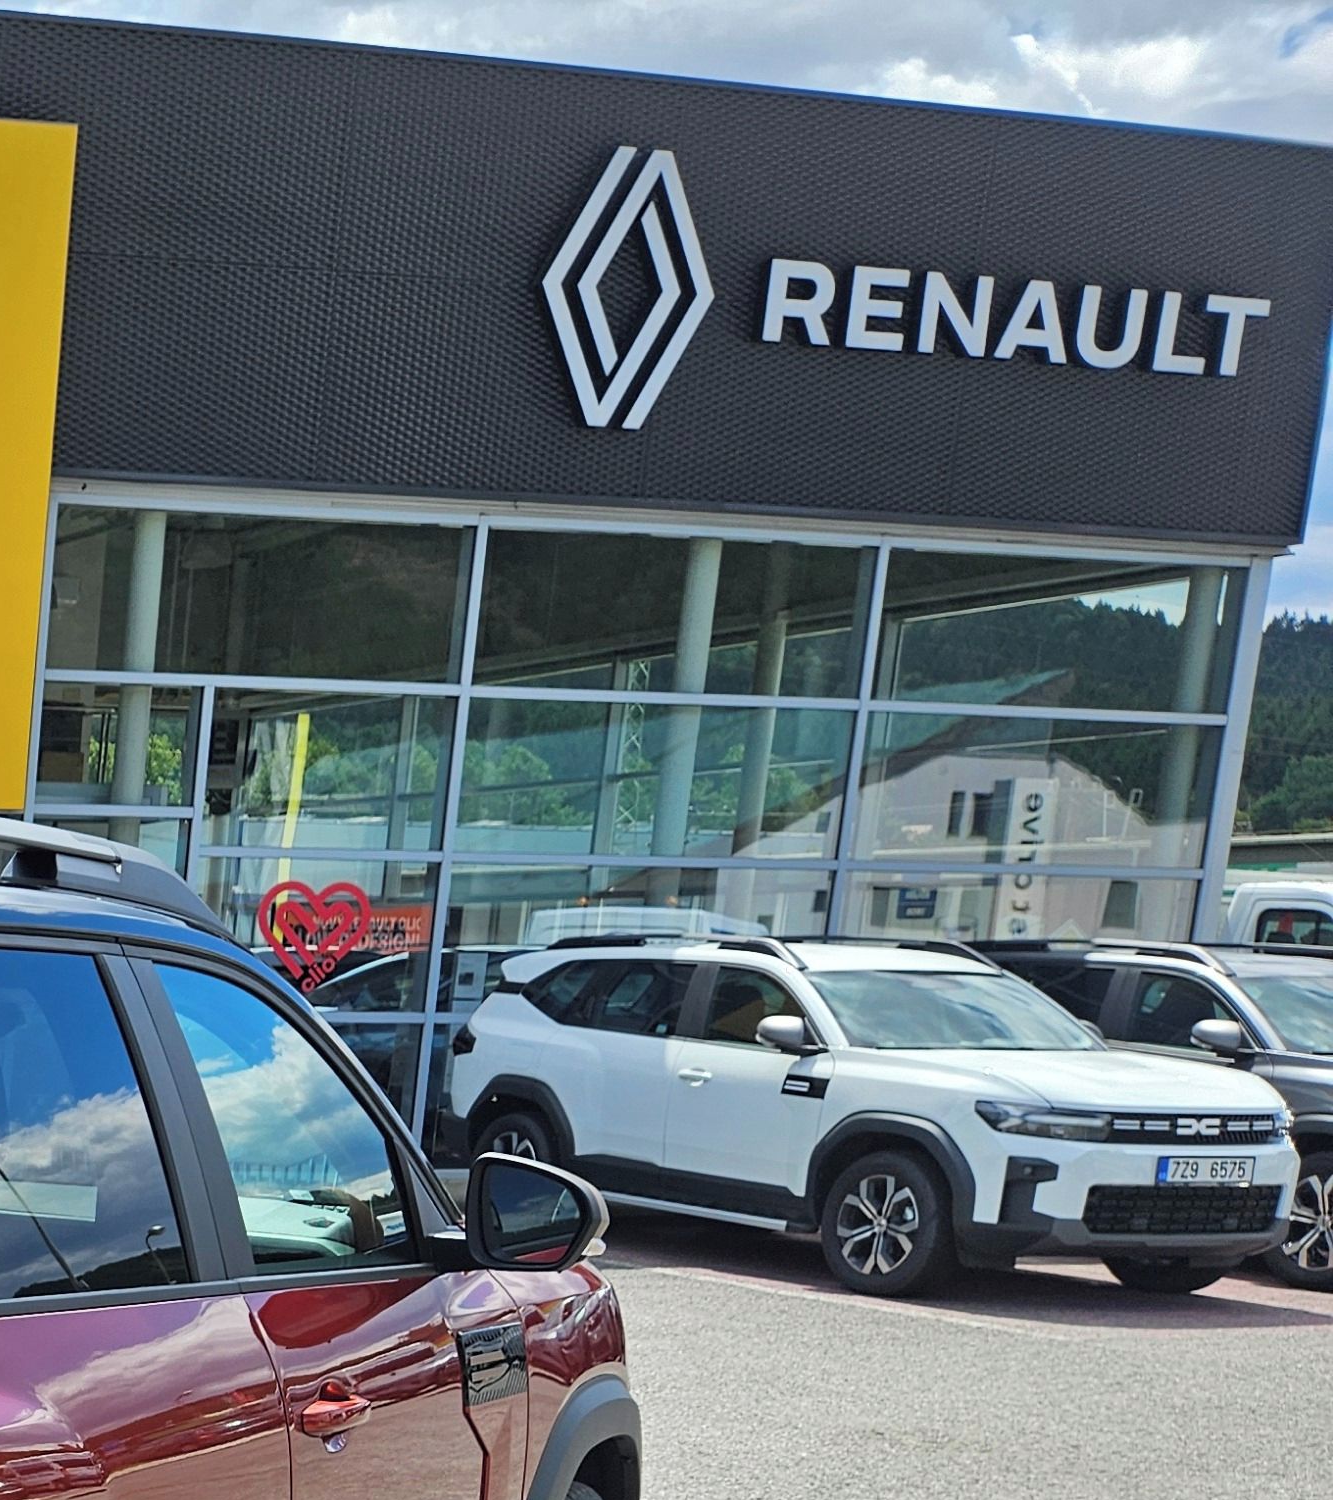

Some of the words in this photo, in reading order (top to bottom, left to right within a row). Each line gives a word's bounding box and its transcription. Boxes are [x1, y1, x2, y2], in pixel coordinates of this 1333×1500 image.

[762, 258, 1271, 377] RENAULT
[301, 957, 336, 993] clio
[1170, 1160, 1199, 1179] 7Z9
[1210, 1160, 1247, 1180] 6575
